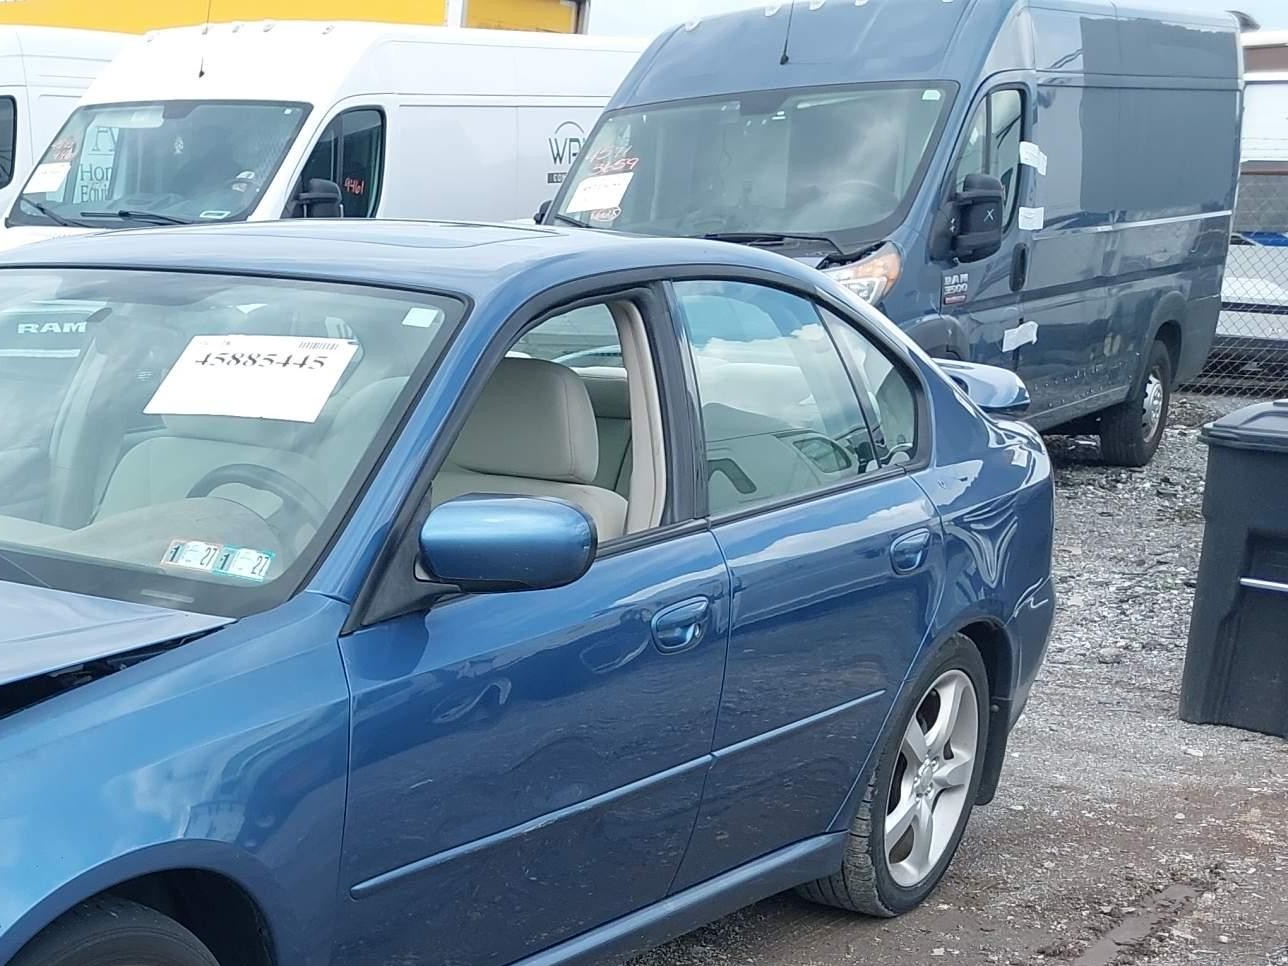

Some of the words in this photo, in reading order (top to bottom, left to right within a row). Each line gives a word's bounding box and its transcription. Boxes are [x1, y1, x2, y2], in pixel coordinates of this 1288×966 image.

[944, 273, 969, 284] RAM
[17, 321, 88, 334] RAM
[194, 352, 329, 369] 45885445
[200, 546, 218, 567] 27
[251, 555, 269, 576] 27
